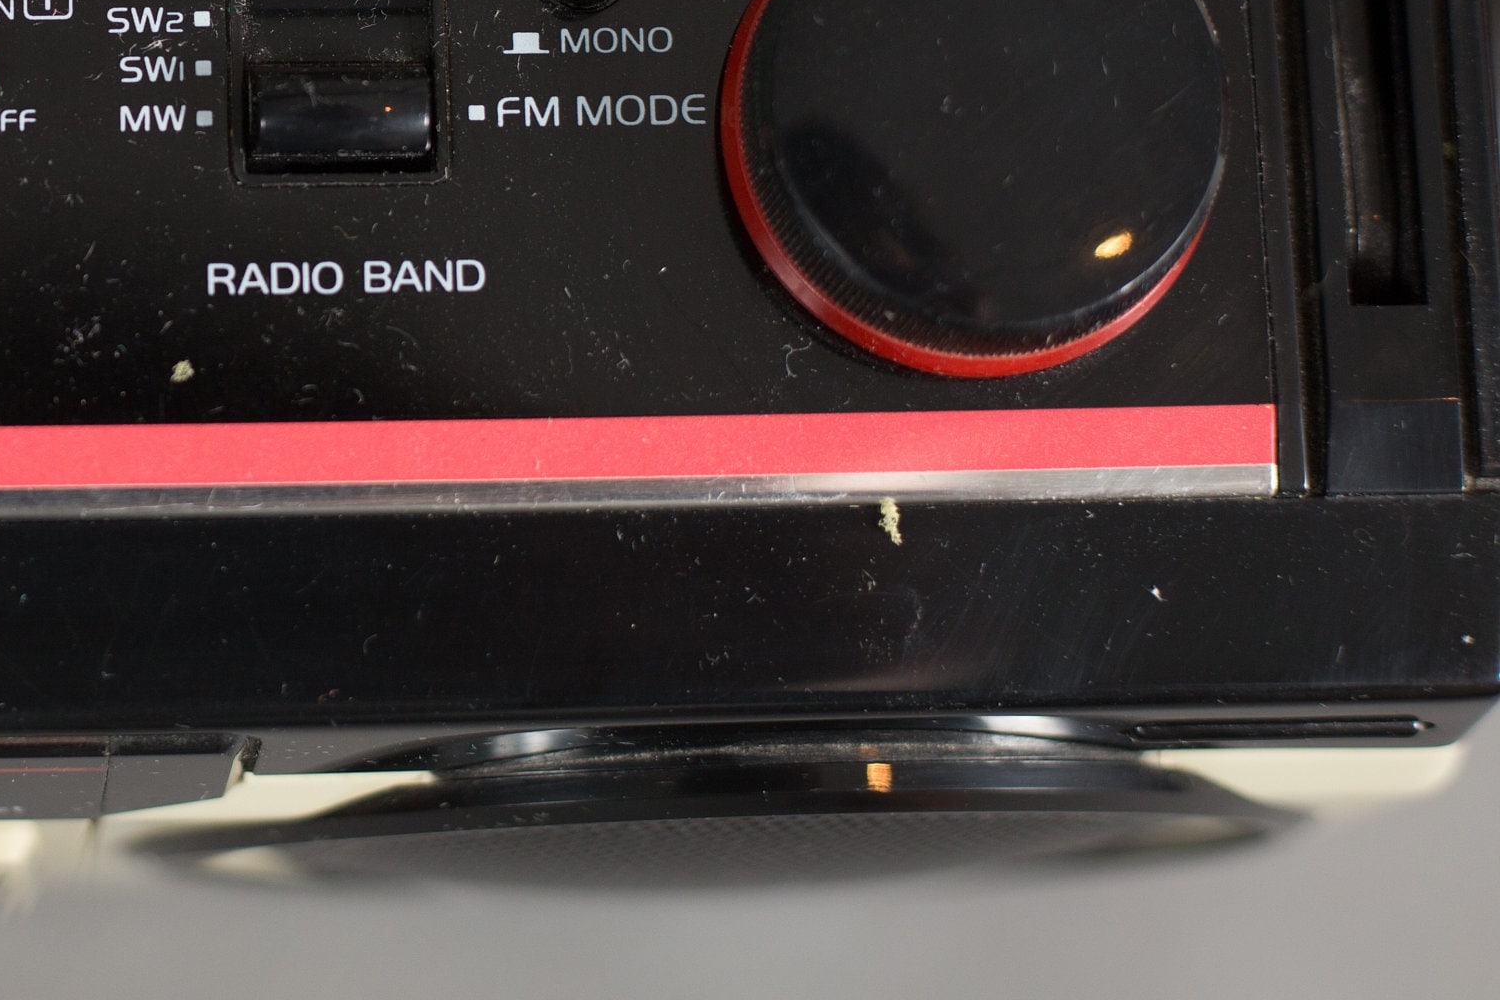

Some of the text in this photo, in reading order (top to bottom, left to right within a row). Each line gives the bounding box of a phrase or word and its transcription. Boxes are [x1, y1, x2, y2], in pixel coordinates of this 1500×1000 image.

[560, 26, 673, 54] MONO
[119, 104, 187, 132] MW
[496, 93, 706, 128] FM MODE
[207, 259, 486, 296] RADIO BAND
